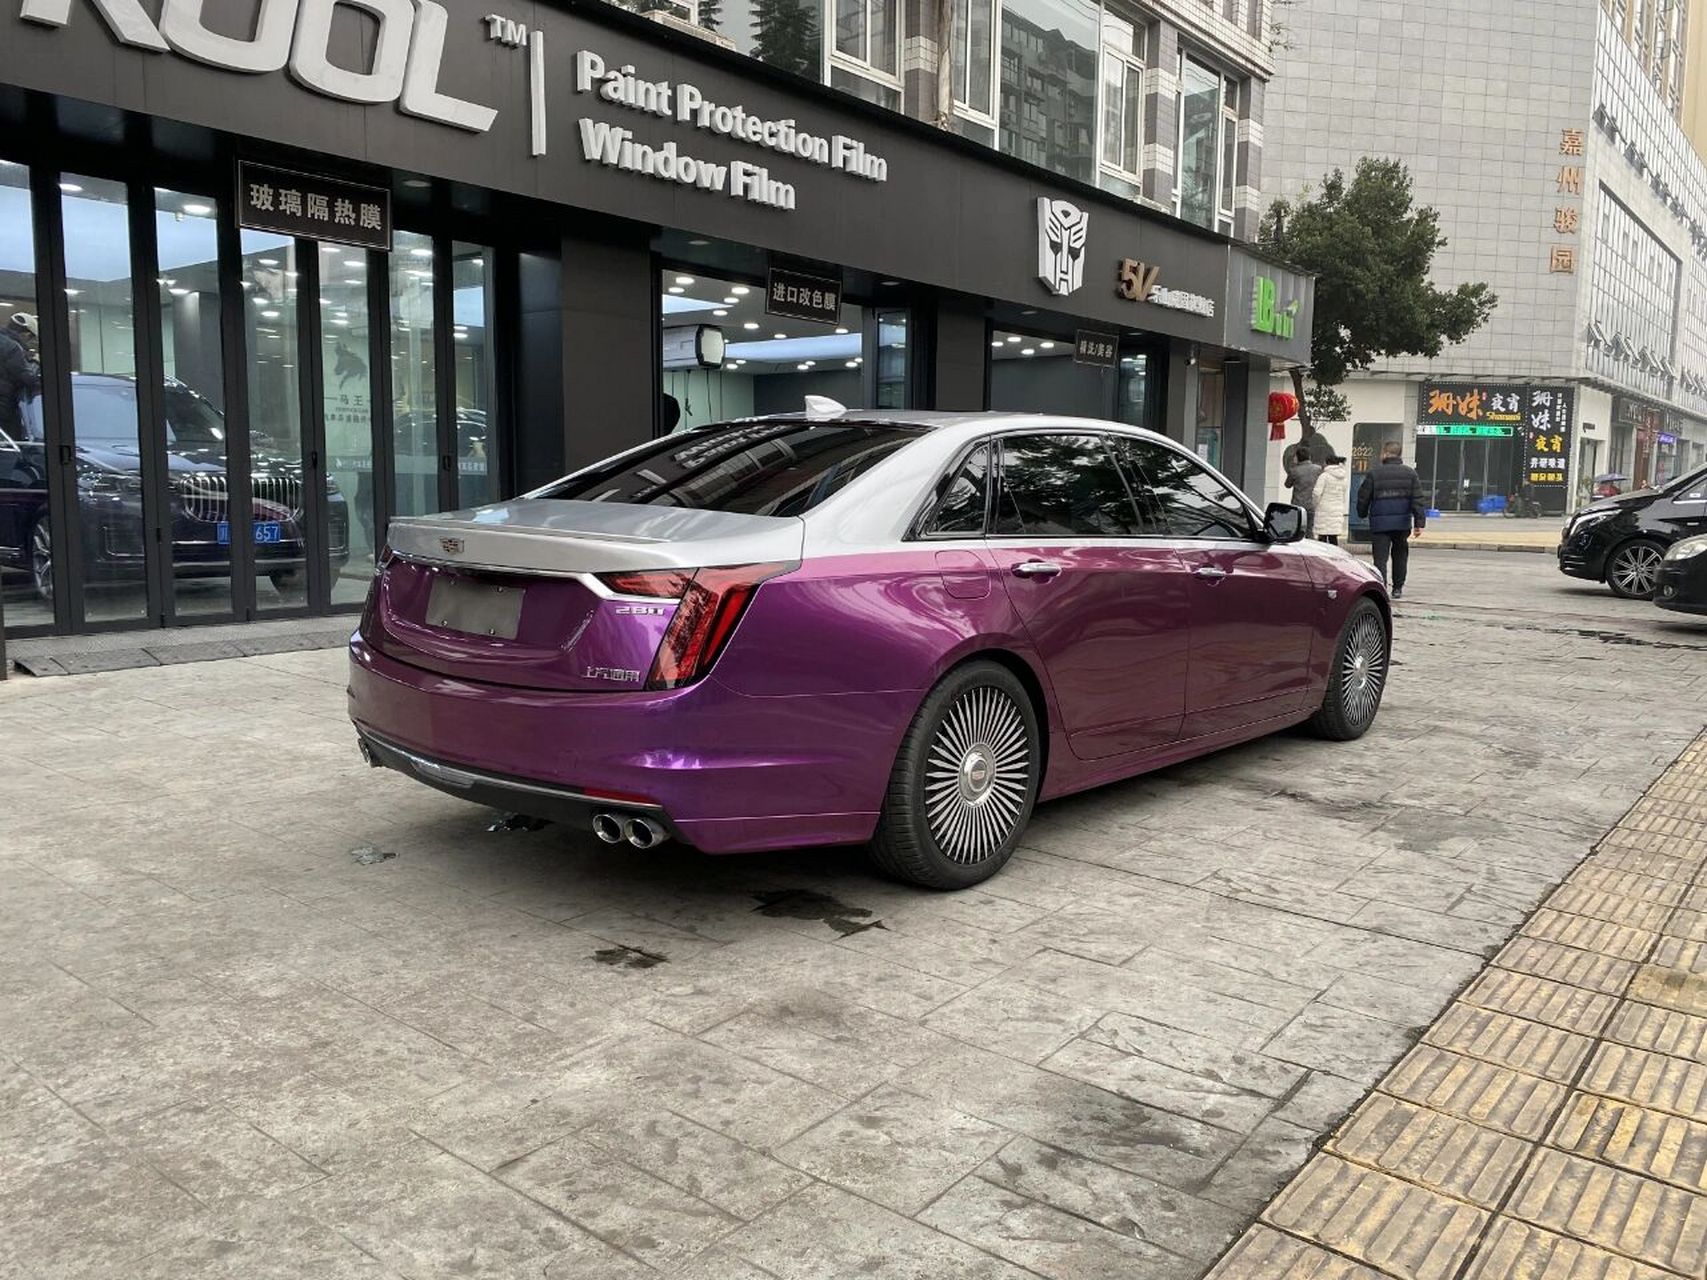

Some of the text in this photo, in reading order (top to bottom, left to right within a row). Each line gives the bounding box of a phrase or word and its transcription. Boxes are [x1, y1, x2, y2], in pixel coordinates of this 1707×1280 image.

[576, 50, 888, 182] Paint Protection Film
[249, 183, 383, 231] 玻璃隔热膜
[578, 118, 796, 210] Window Film
[1550, 128, 1585, 274] 嘉州骏园
[773, 282, 837, 311] 进口改色膜
